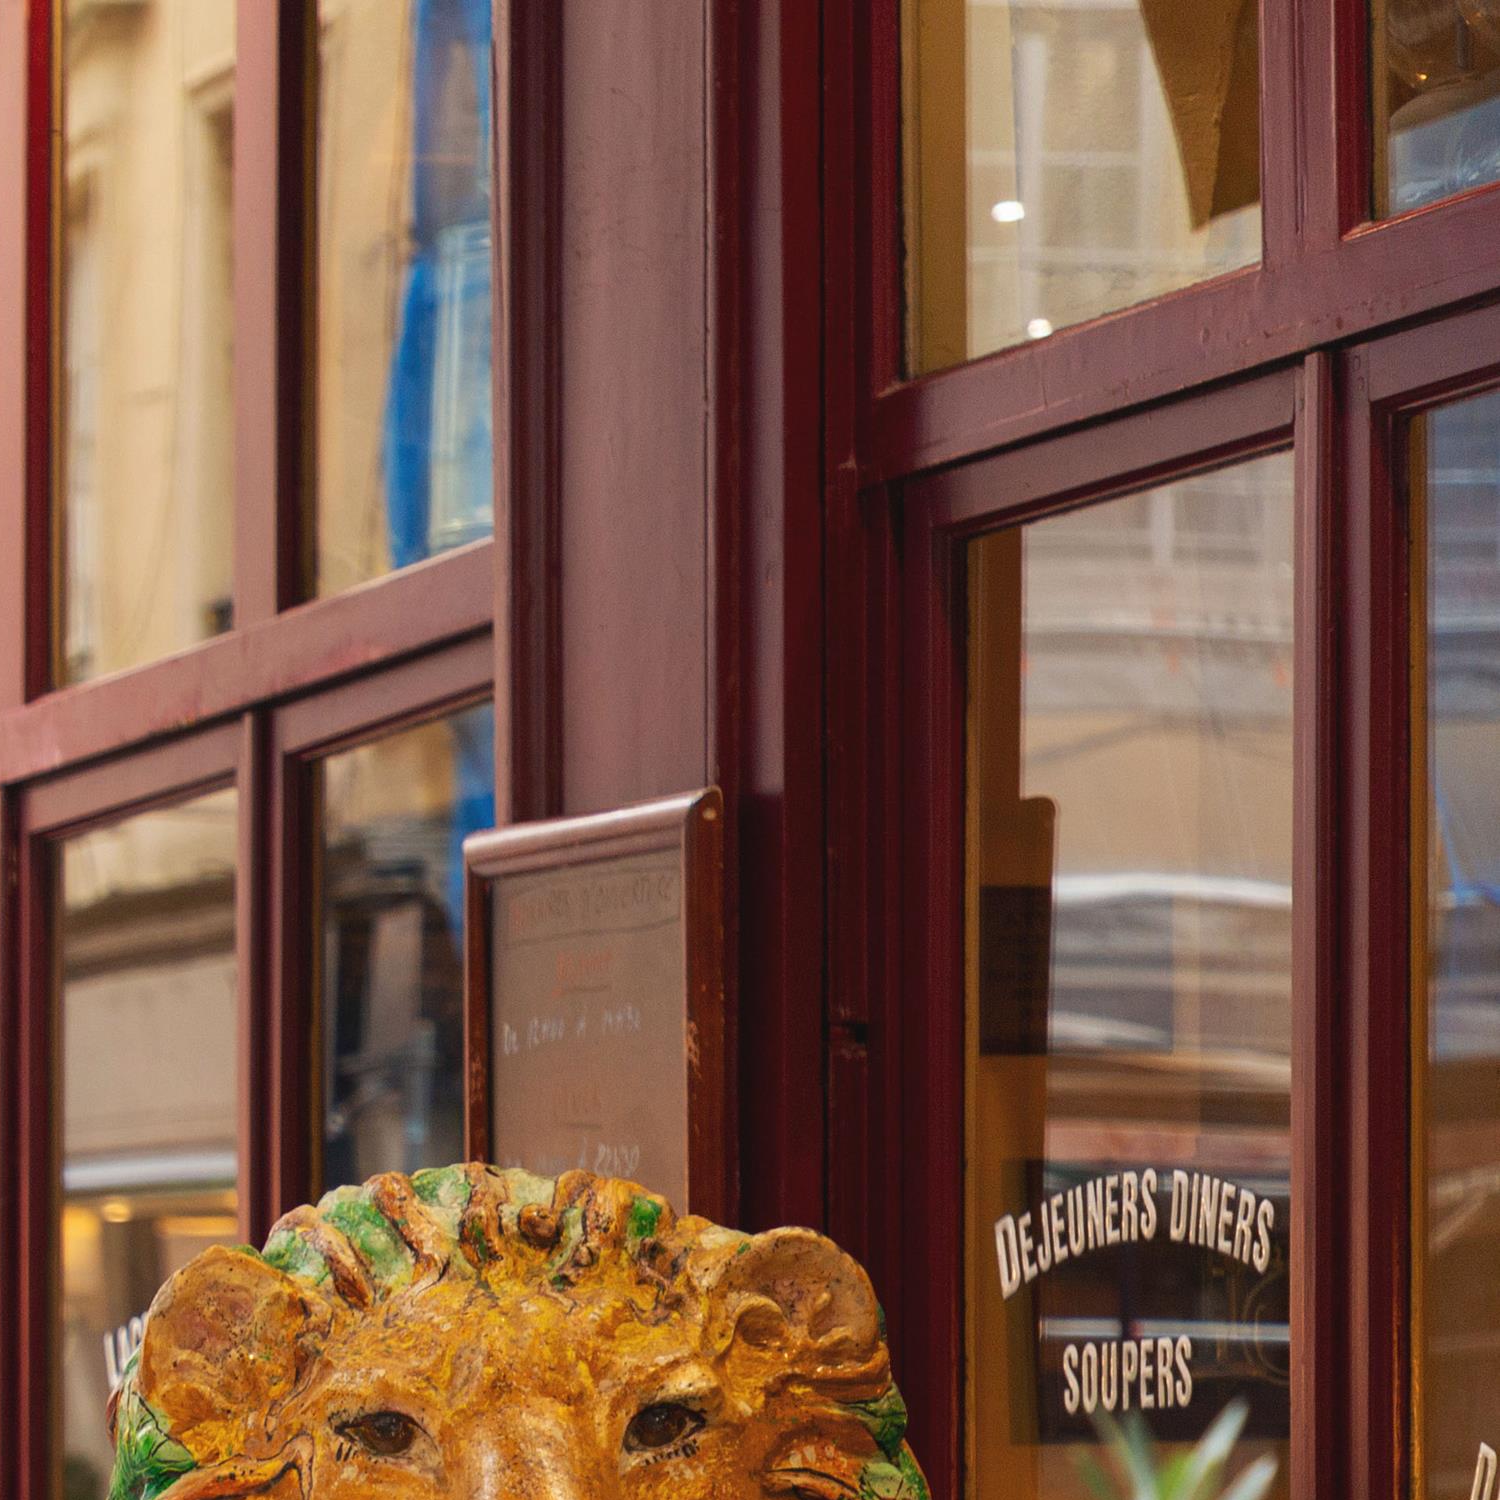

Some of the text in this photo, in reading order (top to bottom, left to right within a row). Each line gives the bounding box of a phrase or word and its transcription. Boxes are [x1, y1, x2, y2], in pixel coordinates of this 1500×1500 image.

[994, 1168, 1274, 1300] DEJEUNERS DINERS
[1062, 1335, 1193, 1415] SOUPERS
